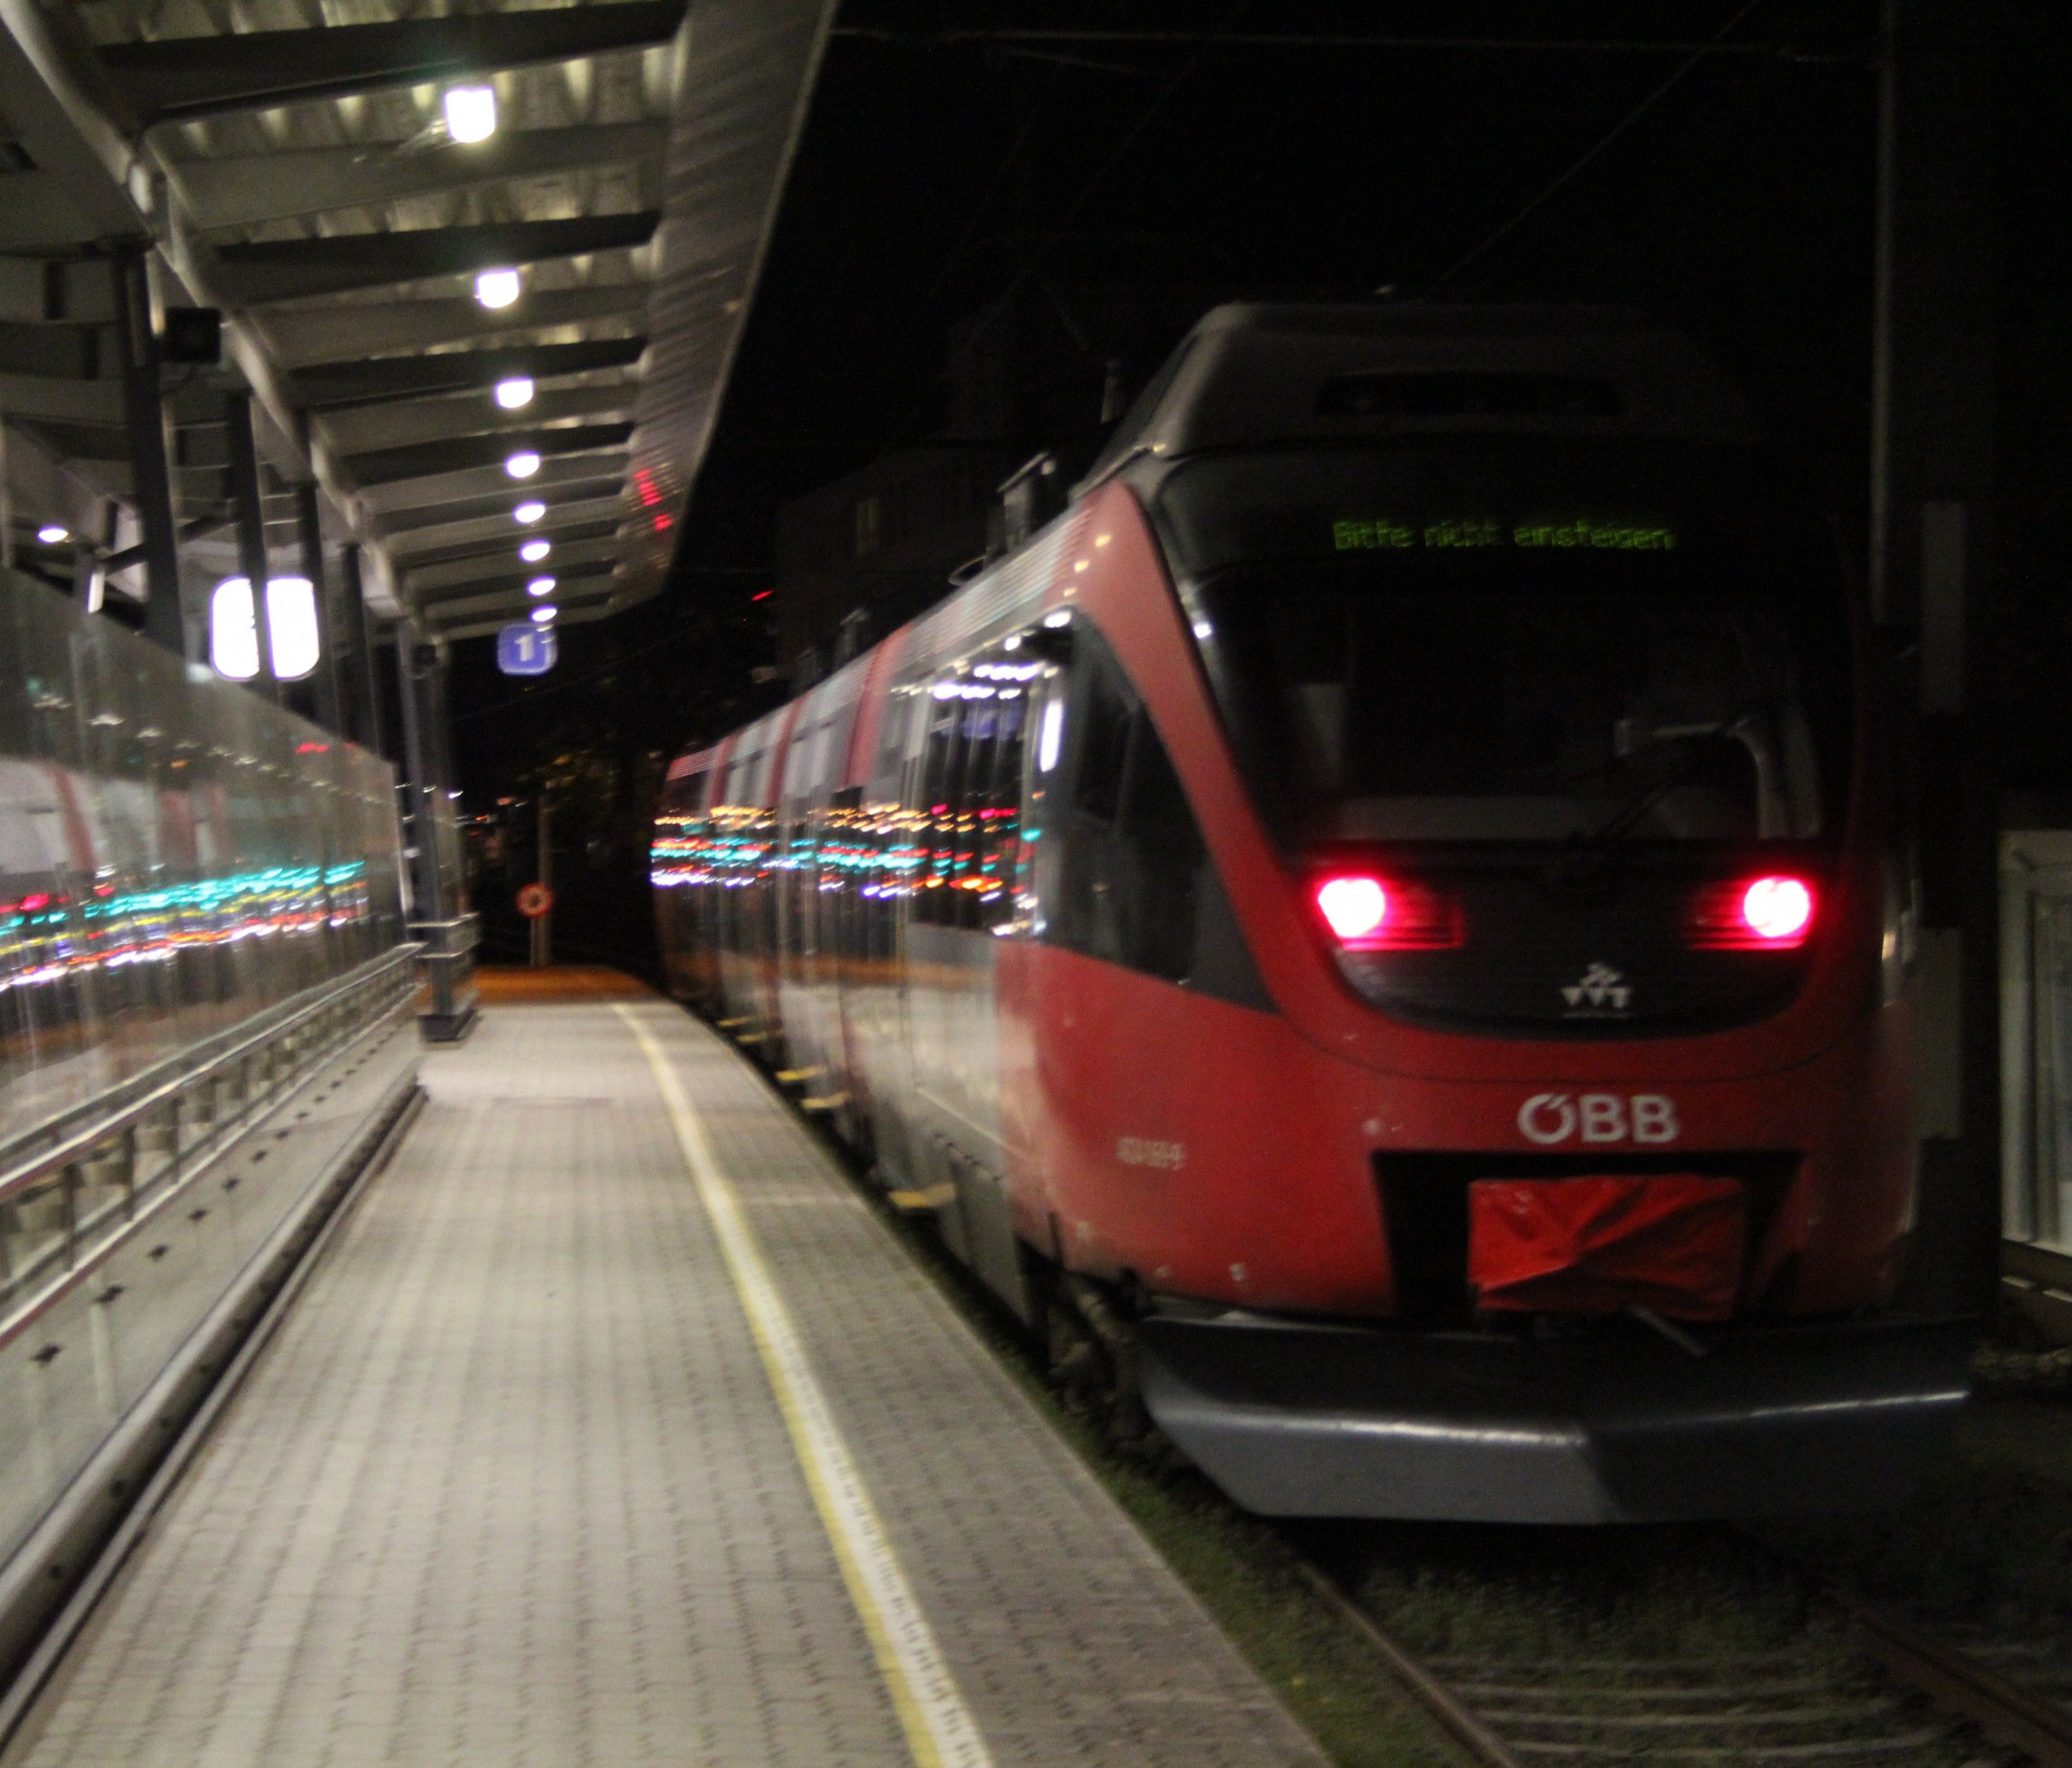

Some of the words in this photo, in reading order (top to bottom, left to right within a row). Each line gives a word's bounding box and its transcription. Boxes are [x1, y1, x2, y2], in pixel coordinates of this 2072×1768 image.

[1333, 520, 1415, 550] Bitte
[514, 632, 535, 662] 1
[1517, 1093, 1680, 1145] ÖBB
